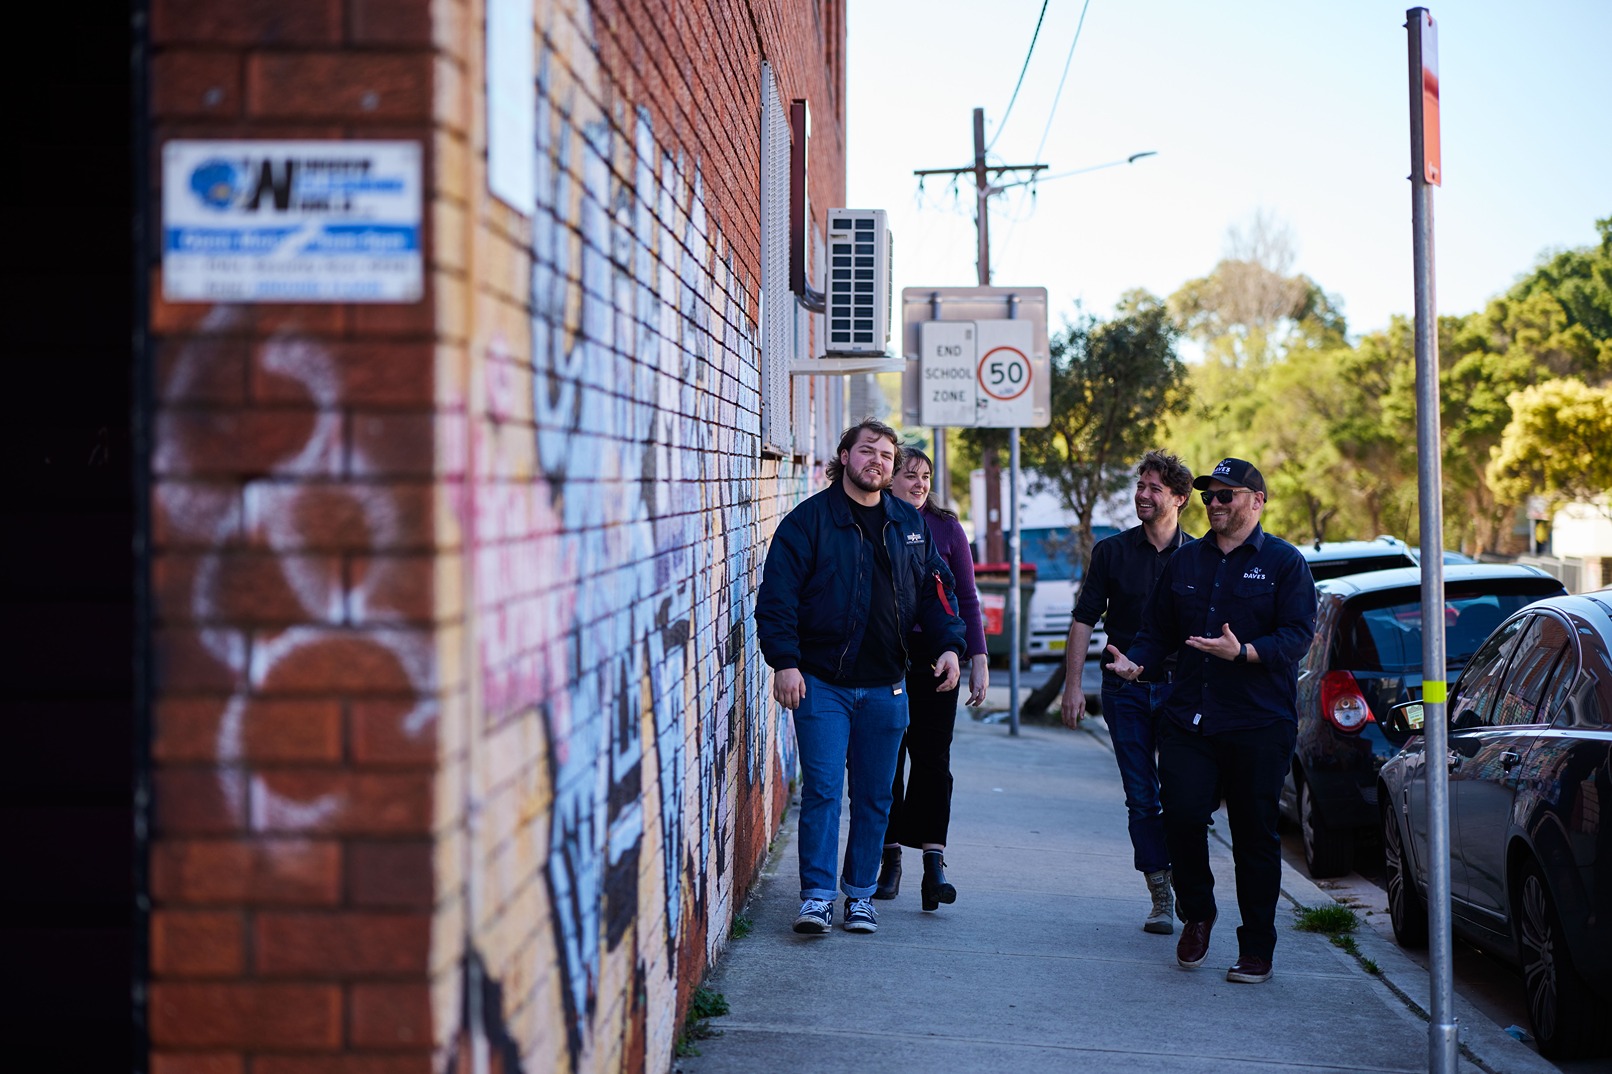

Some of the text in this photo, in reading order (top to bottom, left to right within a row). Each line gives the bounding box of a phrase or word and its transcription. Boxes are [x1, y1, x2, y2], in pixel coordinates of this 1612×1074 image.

[936, 345, 962, 357] END
[925, 367, 973, 380] SCHOOL
[990, 361, 1023, 385] 50
[932, 390, 967, 402] ZONE
